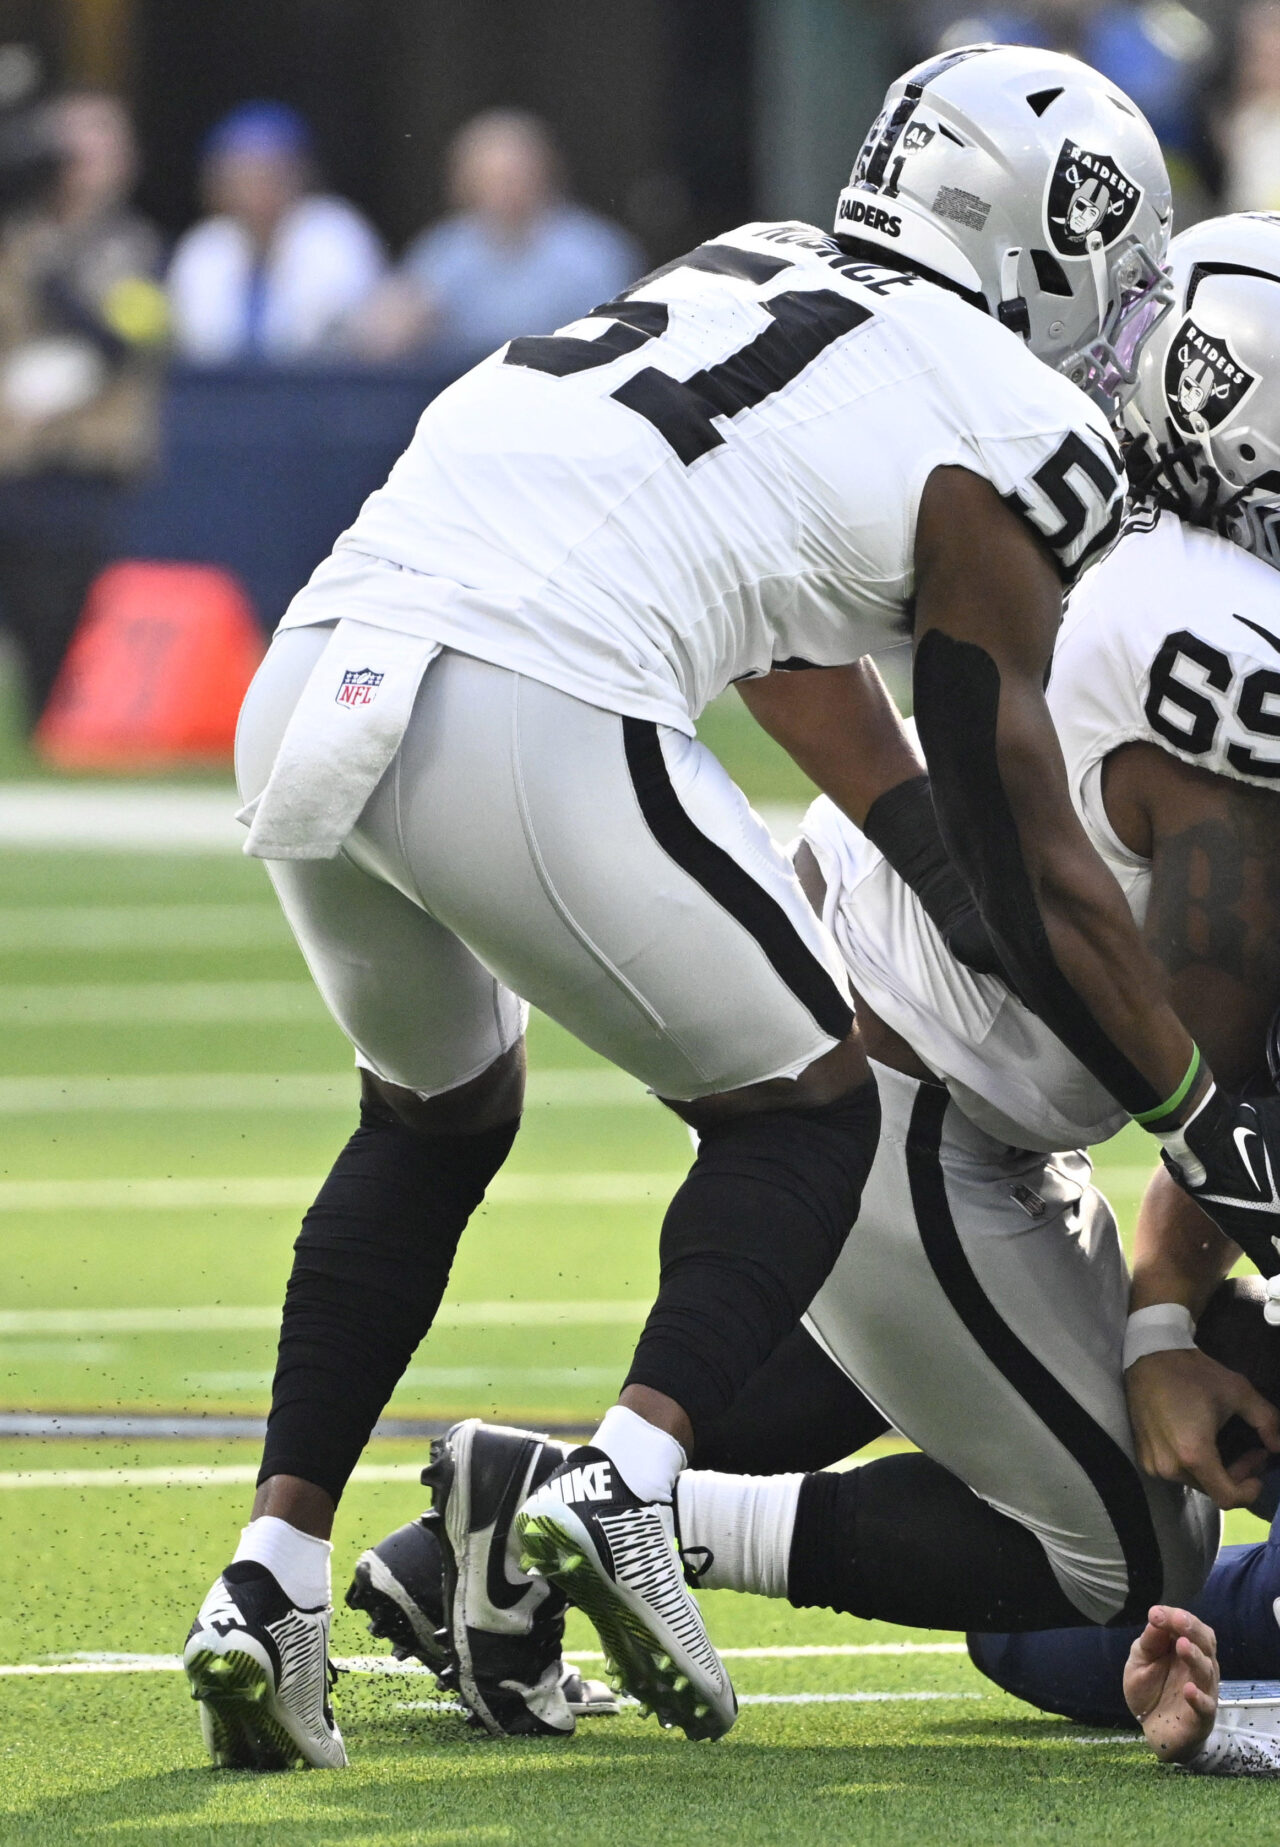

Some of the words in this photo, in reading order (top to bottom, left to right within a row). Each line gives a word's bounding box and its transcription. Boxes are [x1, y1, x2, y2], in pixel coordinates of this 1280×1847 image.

[905, 126, 928, 147] AL
[1070, 146, 1136, 200] RAIDERS
[502, 244, 876, 468] 51
[1185, 326, 1246, 384] RAIDERS
[1003, 422, 1126, 584] 5
[338, 684, 373, 706] NFL
[536, 1460, 613, 1505] NIKE
